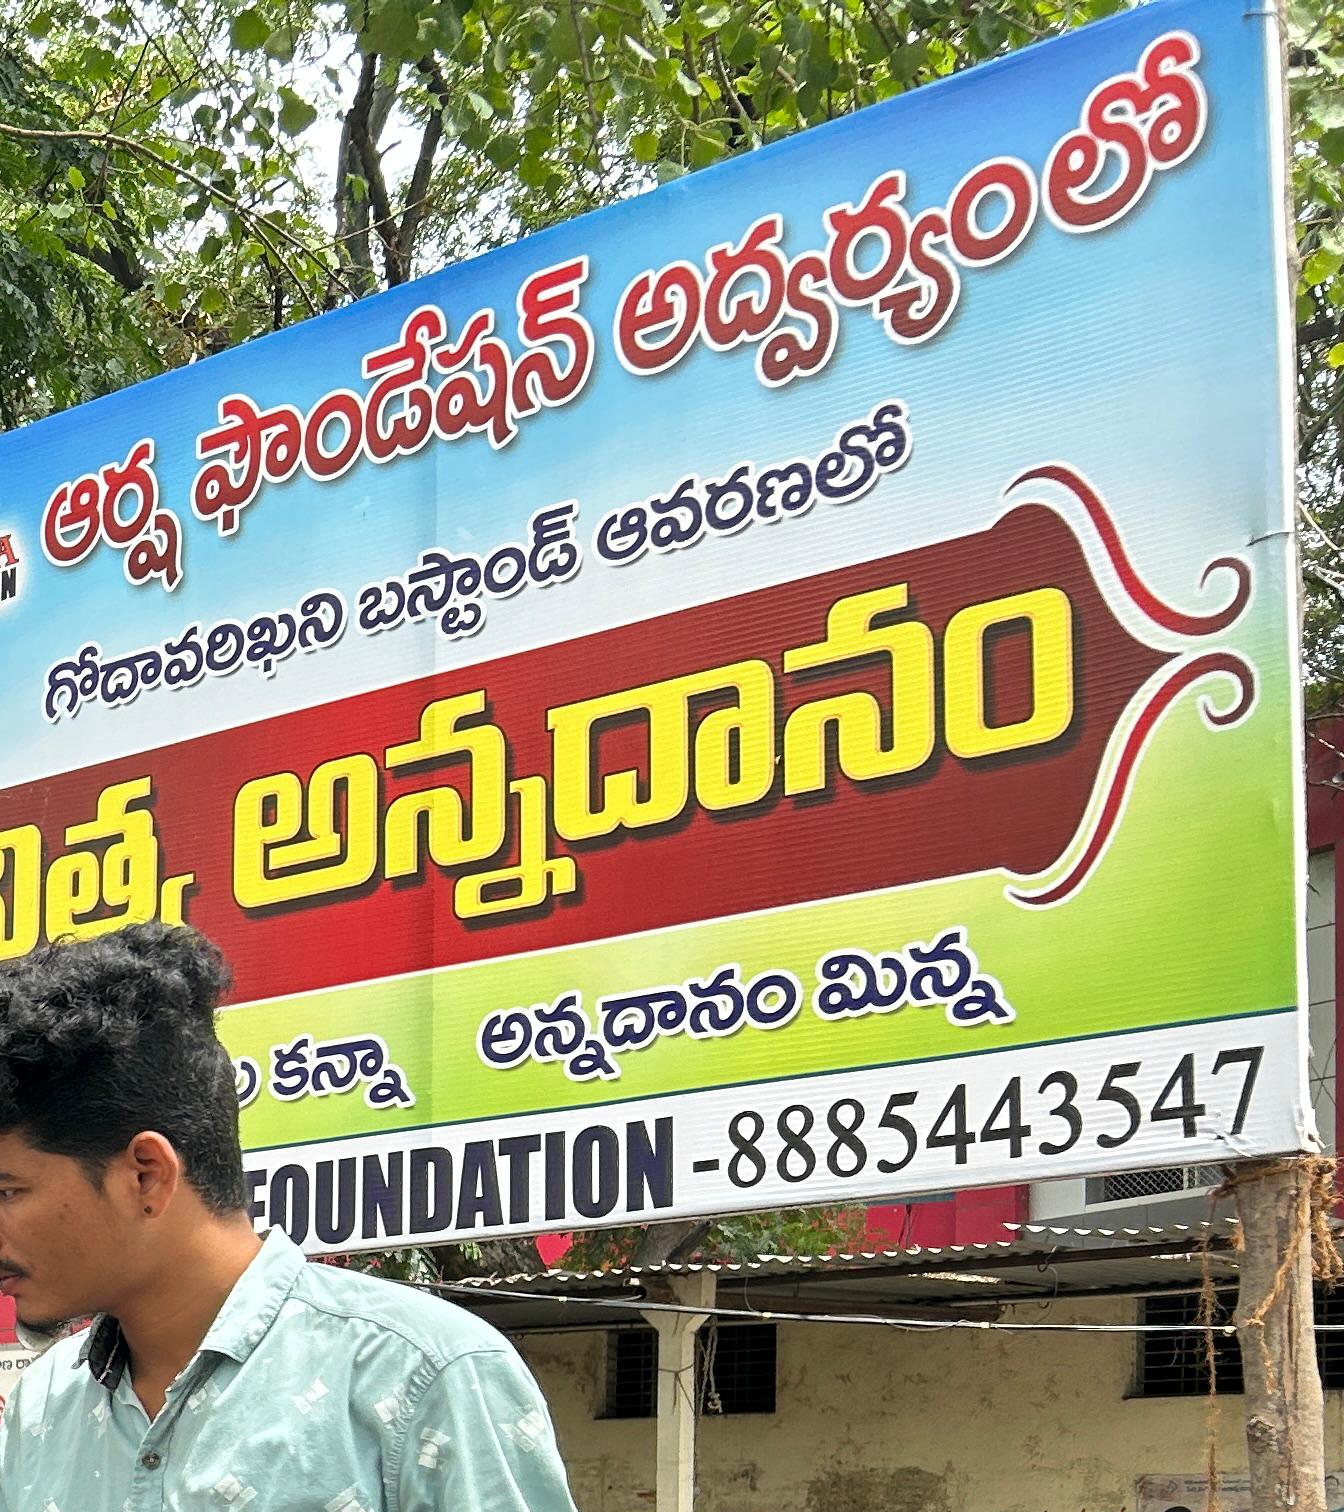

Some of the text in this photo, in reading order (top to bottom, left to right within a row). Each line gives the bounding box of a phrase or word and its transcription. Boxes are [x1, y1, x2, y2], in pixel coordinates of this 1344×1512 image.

[43, 439, 180, 588] ఆర్ష
[45, 405, 910, 722] గోదావరిఖని బస్టాండ్ ఆవరణలో
[232, 582, 1074, 920] అన్నదానం
[272, 1038, 410, 1103] కన్నా
[481, 964, 797, 1079] అన్నదానం
[819, 930, 1009, 1023] మిన్న
[245, 1118, 674, 1246] FOUNDATION
